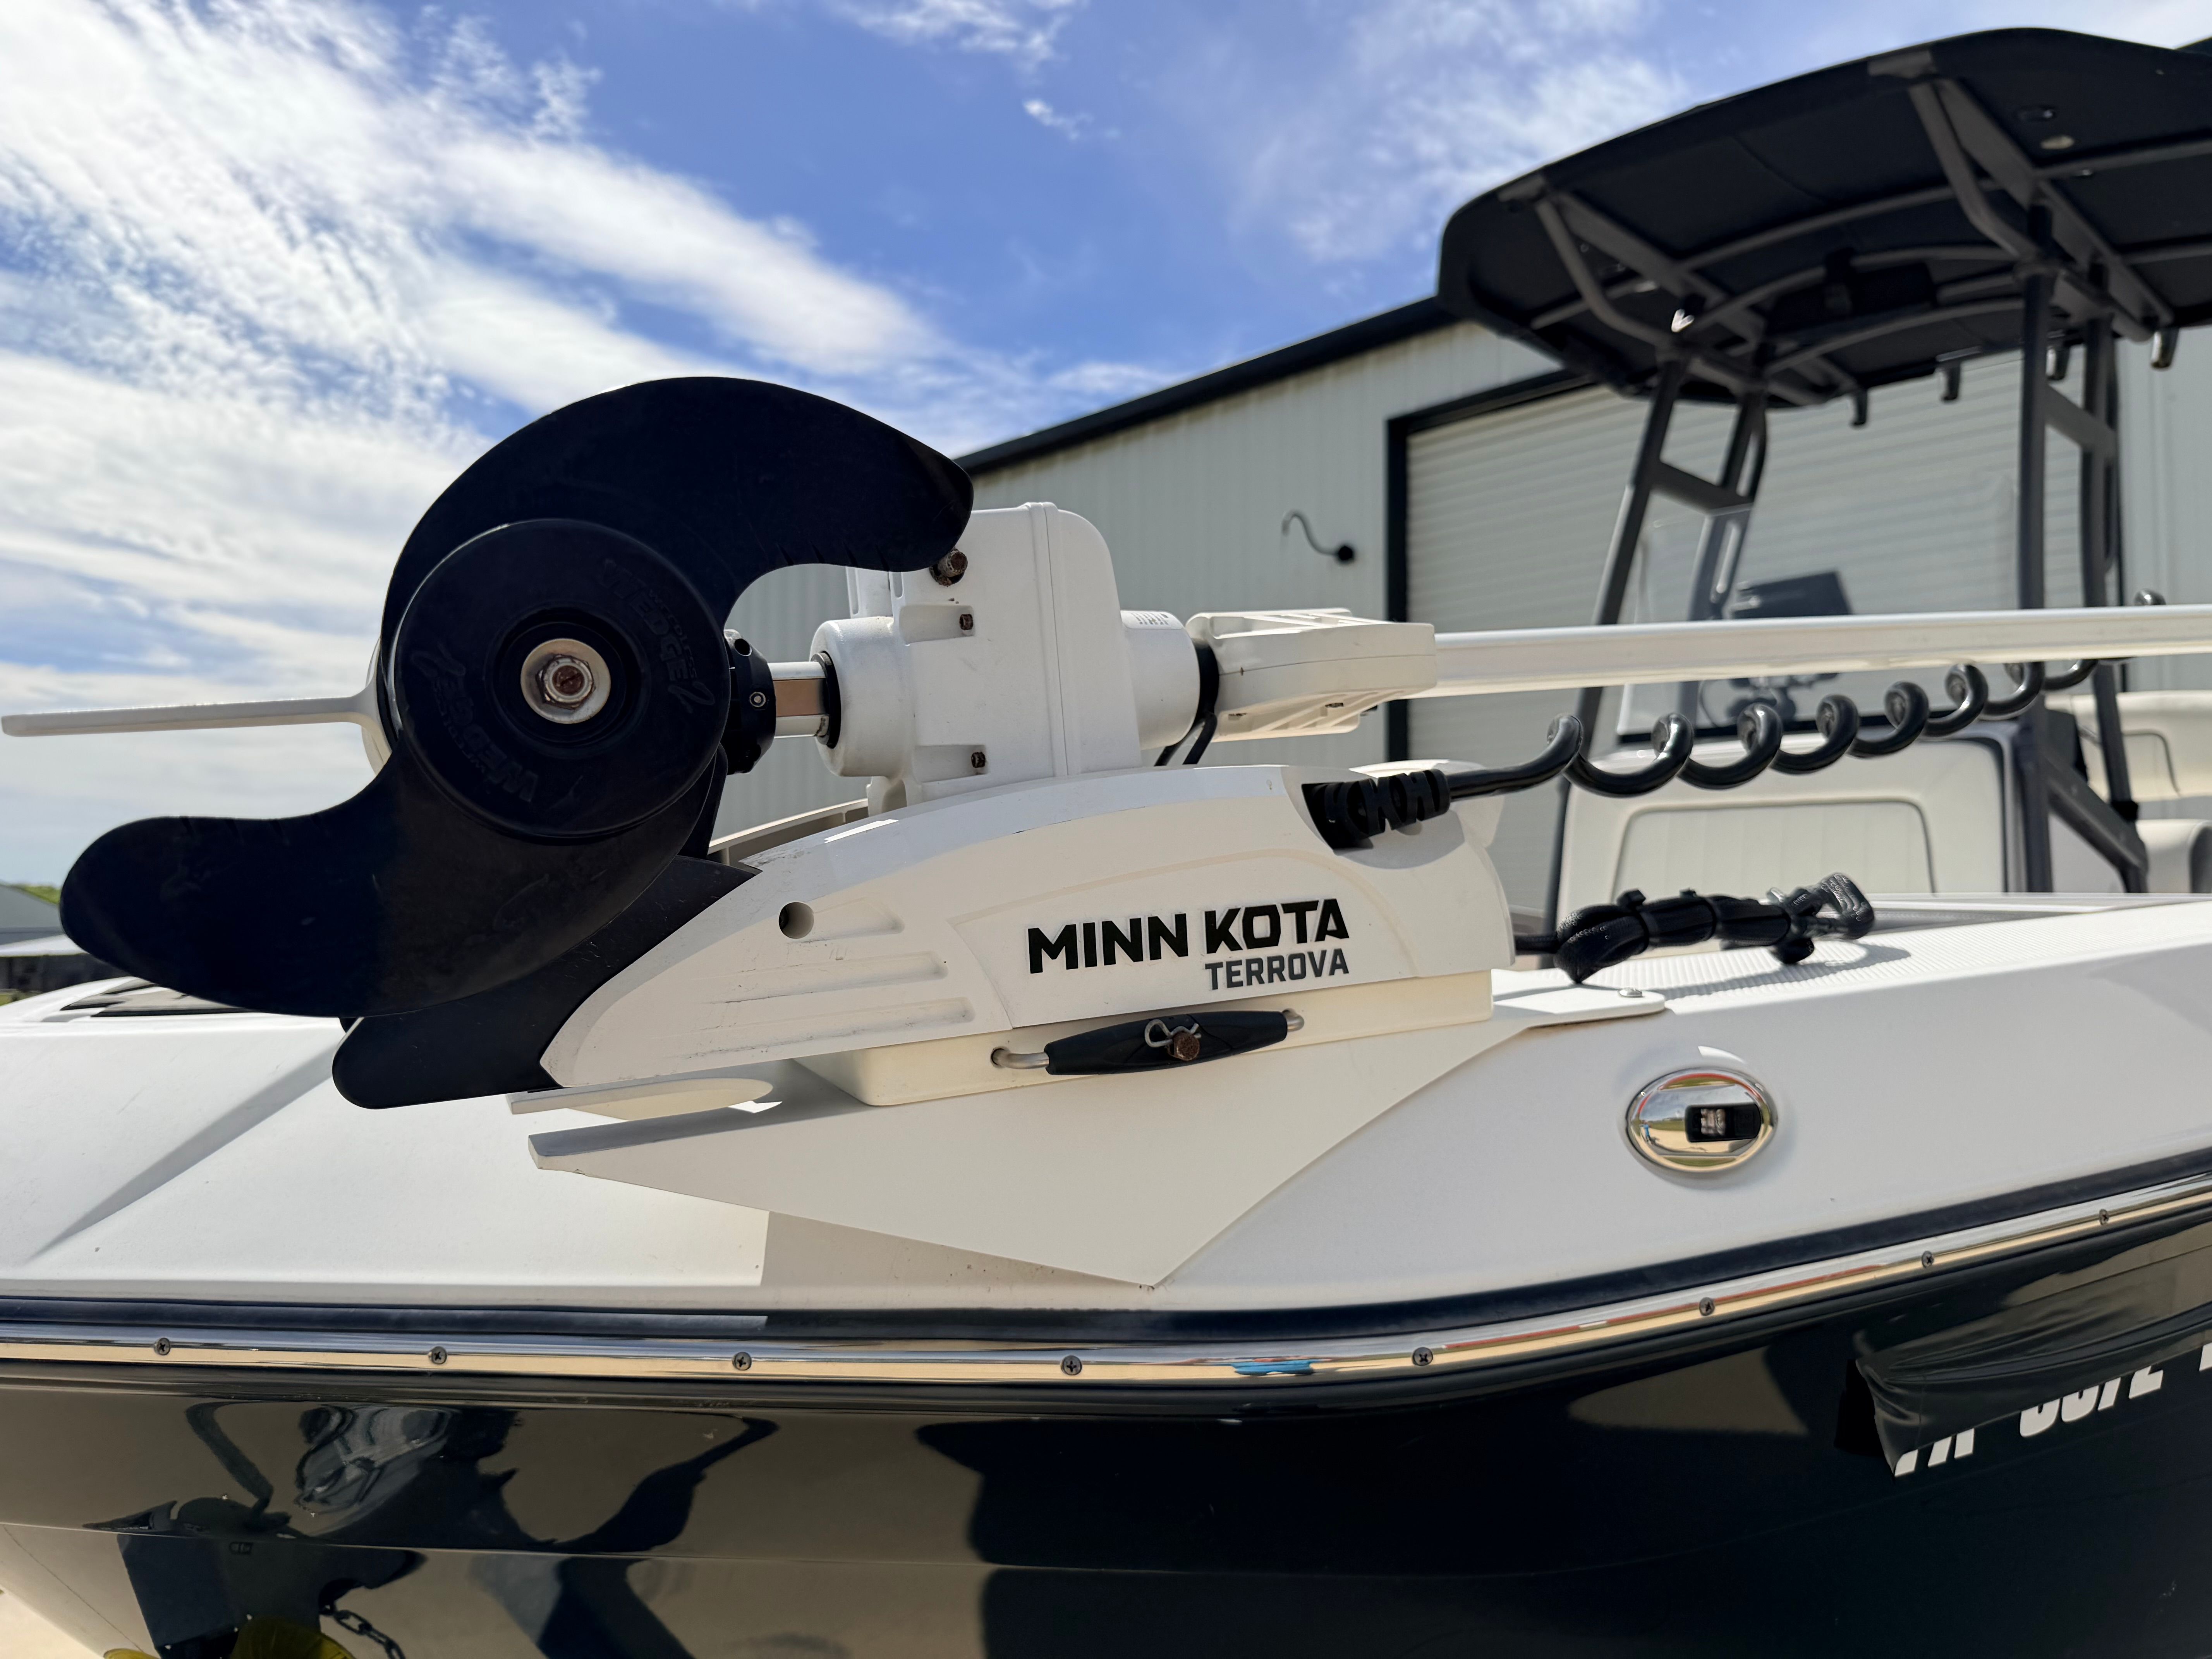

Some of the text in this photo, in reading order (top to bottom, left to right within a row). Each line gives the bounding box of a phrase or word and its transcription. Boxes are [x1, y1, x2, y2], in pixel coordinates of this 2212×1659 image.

[594, 557, 690, 682] WEDGE
[1028, 898, 1350, 974] MINN KOTA
[1204, 947, 1350, 991] TERROVA
